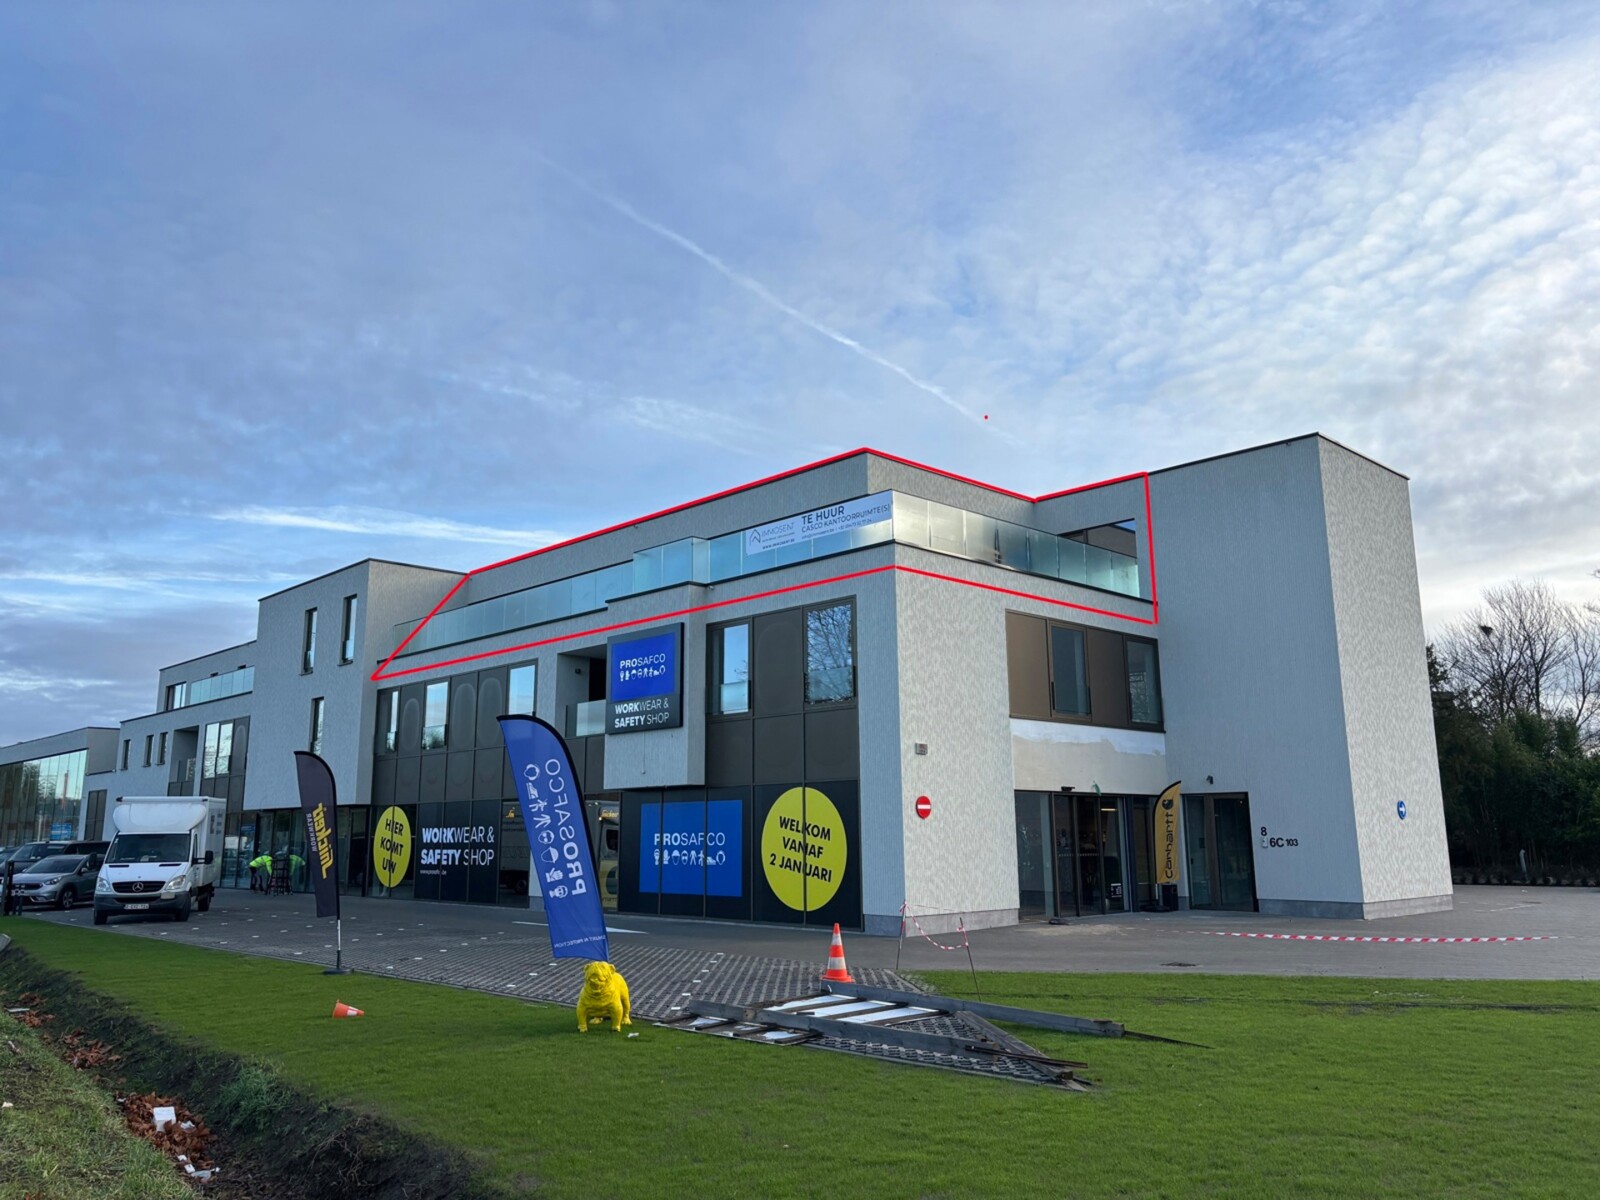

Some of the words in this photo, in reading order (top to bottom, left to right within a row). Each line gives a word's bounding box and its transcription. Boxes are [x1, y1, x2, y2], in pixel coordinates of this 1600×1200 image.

[801, 514, 813, 525] TE
[816, 505, 845, 521] HUUR
[801, 522, 823, 533] CASCO
[824, 503, 890, 527] KANTOORRUIMTE(S)
[620, 653, 666, 669] PROSAFCO
[614, 699, 662, 715] WORKWEAR
[663, 698, 669, 709] &
[614, 715, 646, 729] SAFETY
[646, 712, 670, 725] SHOP
[384, 817, 404, 837] HIER
[421, 825, 485, 844] WORKWEAR
[486, 825, 495, 843] &
[779, 815, 831, 842] WELKOM
[1260, 826, 1267, 837] 8
[380, 836, 404, 857] KOMT
[654, 832, 726, 846] PROSAFCO
[782, 836, 824, 859] VANAF
[1269, 837, 1285, 848] 6C
[1285, 838, 1299, 847] 103
[382, 857, 397, 874] UW
[420, 848, 461, 866] SAFETY
[463, 848, 495, 866] SHOP
[769, 852, 777, 867] 2
[779, 855, 832, 883] JANUARI
